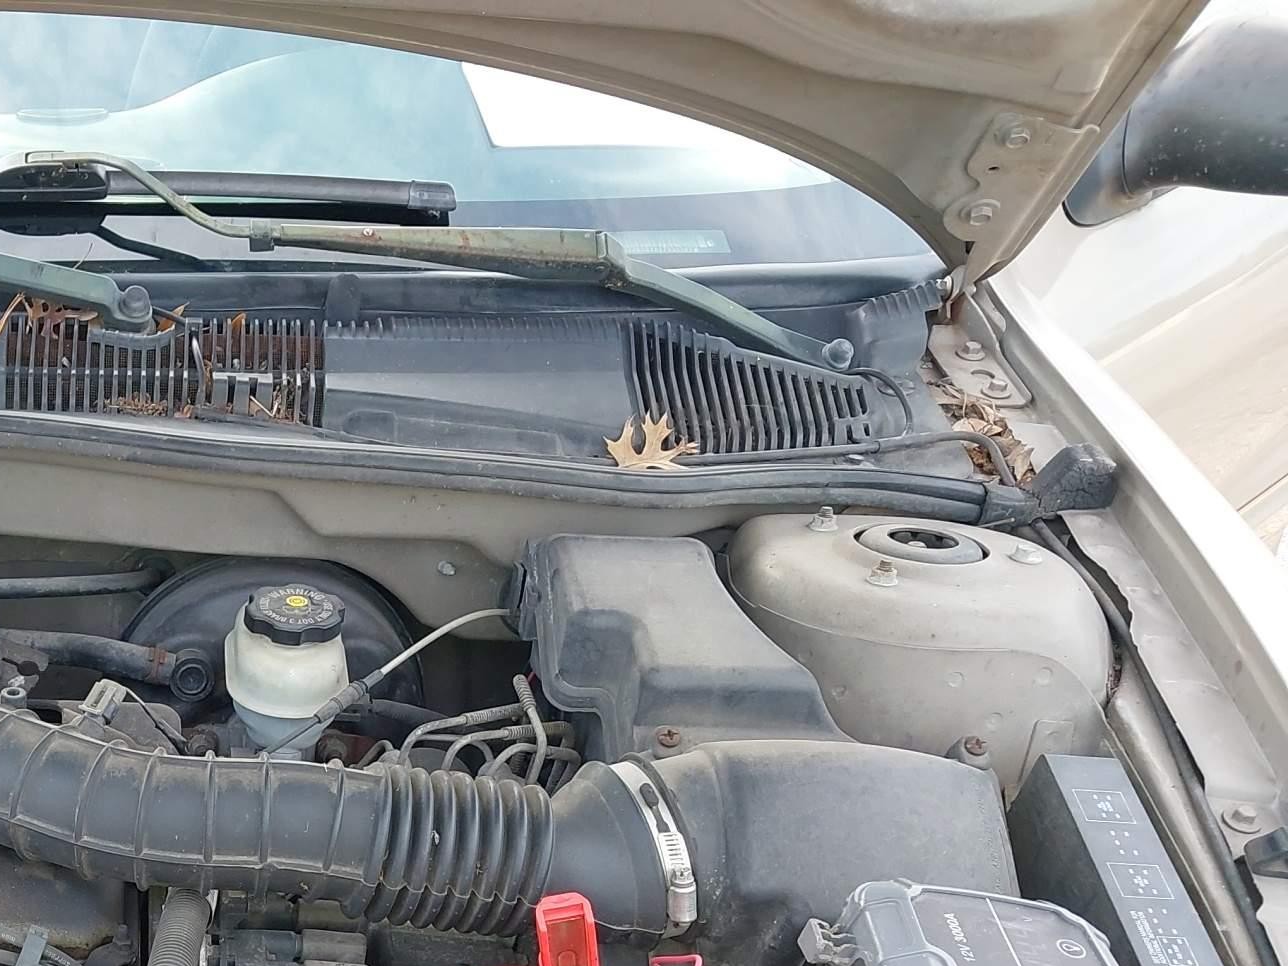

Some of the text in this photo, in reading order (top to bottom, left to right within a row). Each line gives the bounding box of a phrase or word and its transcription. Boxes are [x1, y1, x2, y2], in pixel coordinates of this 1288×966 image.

[267, 588, 325, 601] WARNING
[944, 912, 976, 962] 12V 3000A
